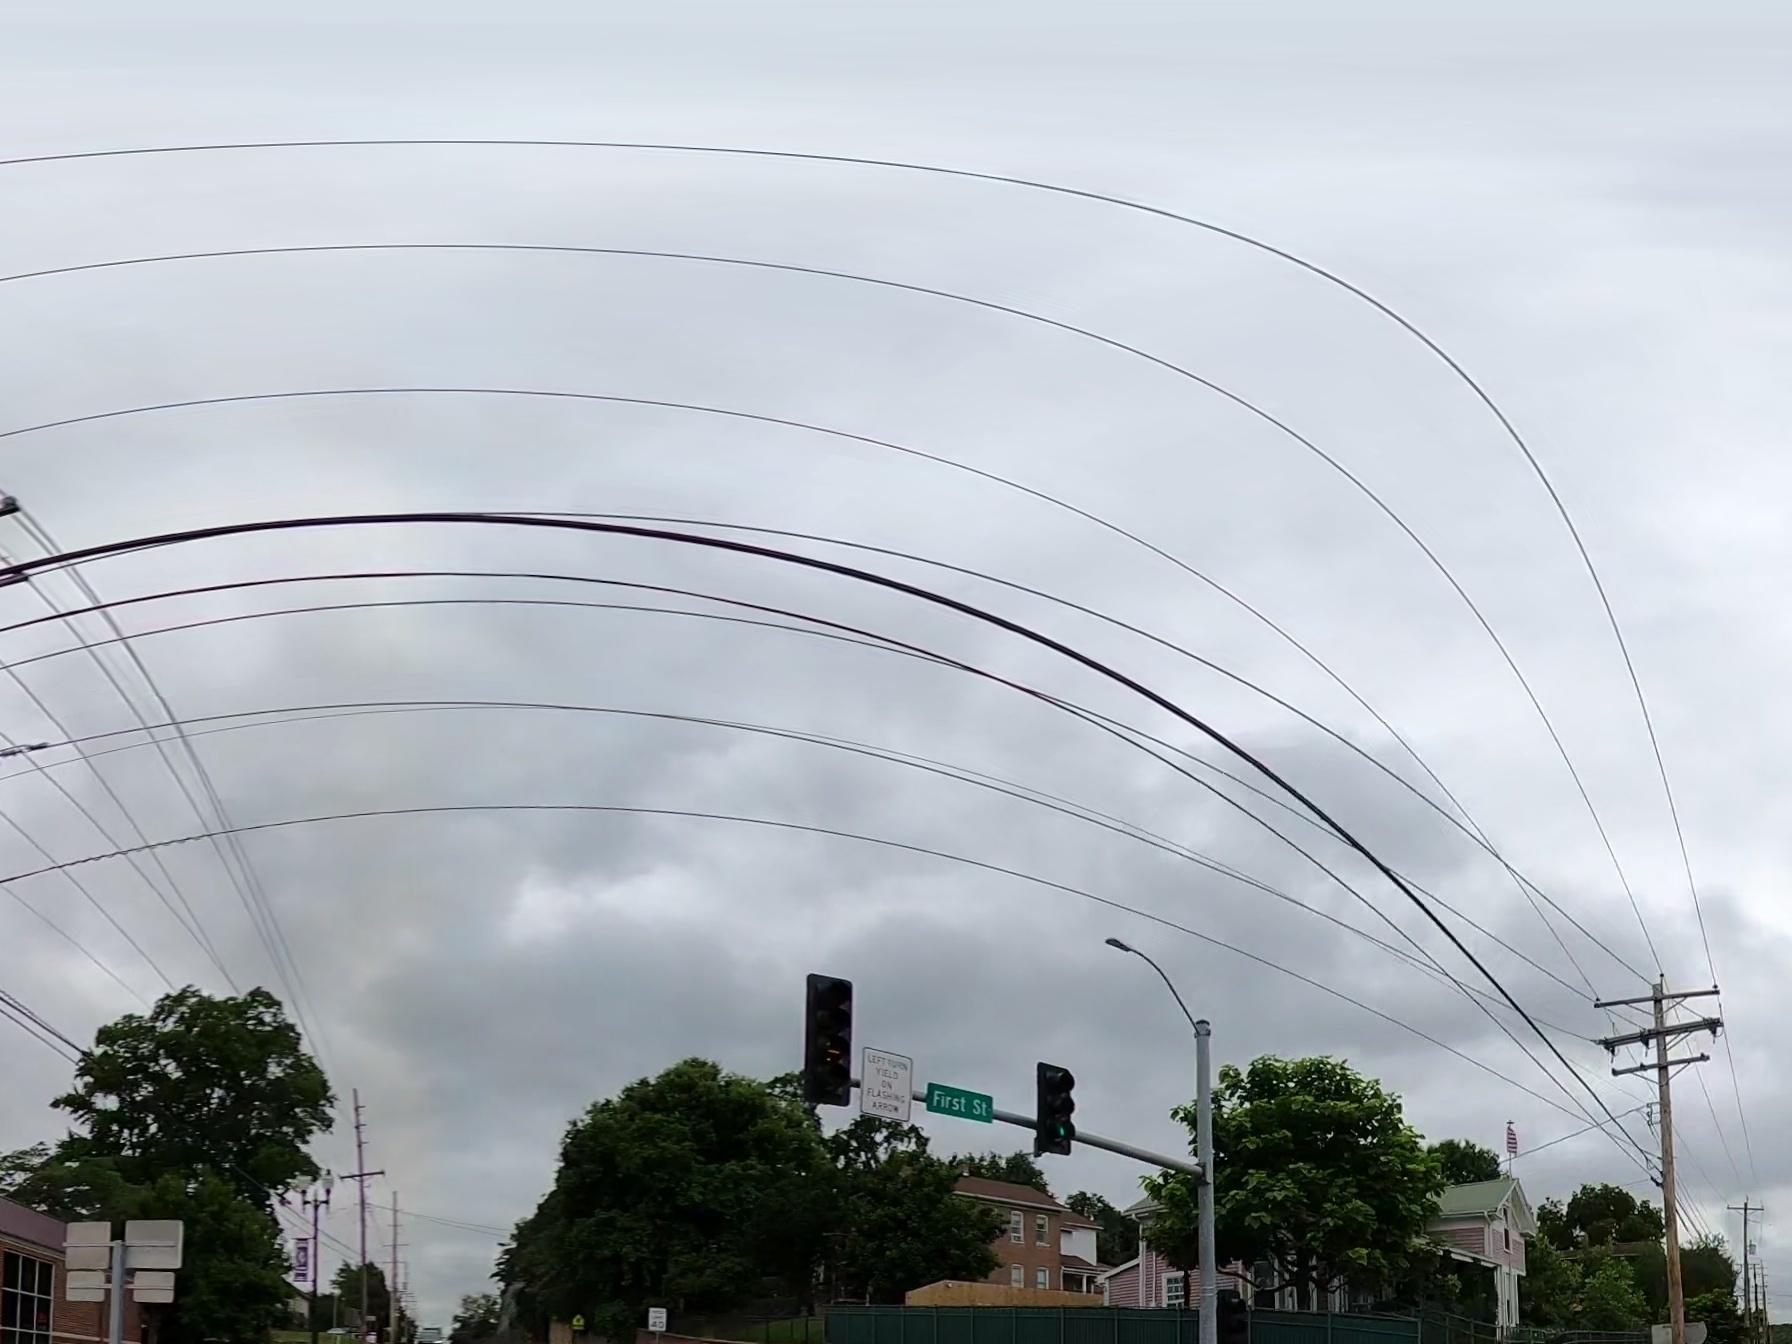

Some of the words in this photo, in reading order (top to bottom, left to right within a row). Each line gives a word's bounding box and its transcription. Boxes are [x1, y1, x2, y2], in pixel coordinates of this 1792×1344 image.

[867, 1054, 885, 1065] LEFT
[875, 1066, 898, 1080] YIELD
[881, 1079, 892, 1090] ON
[871, 1101, 899, 1113] ARROW
[932, 1090, 966, 1112] First
[972, 1098, 988, 1117] St
